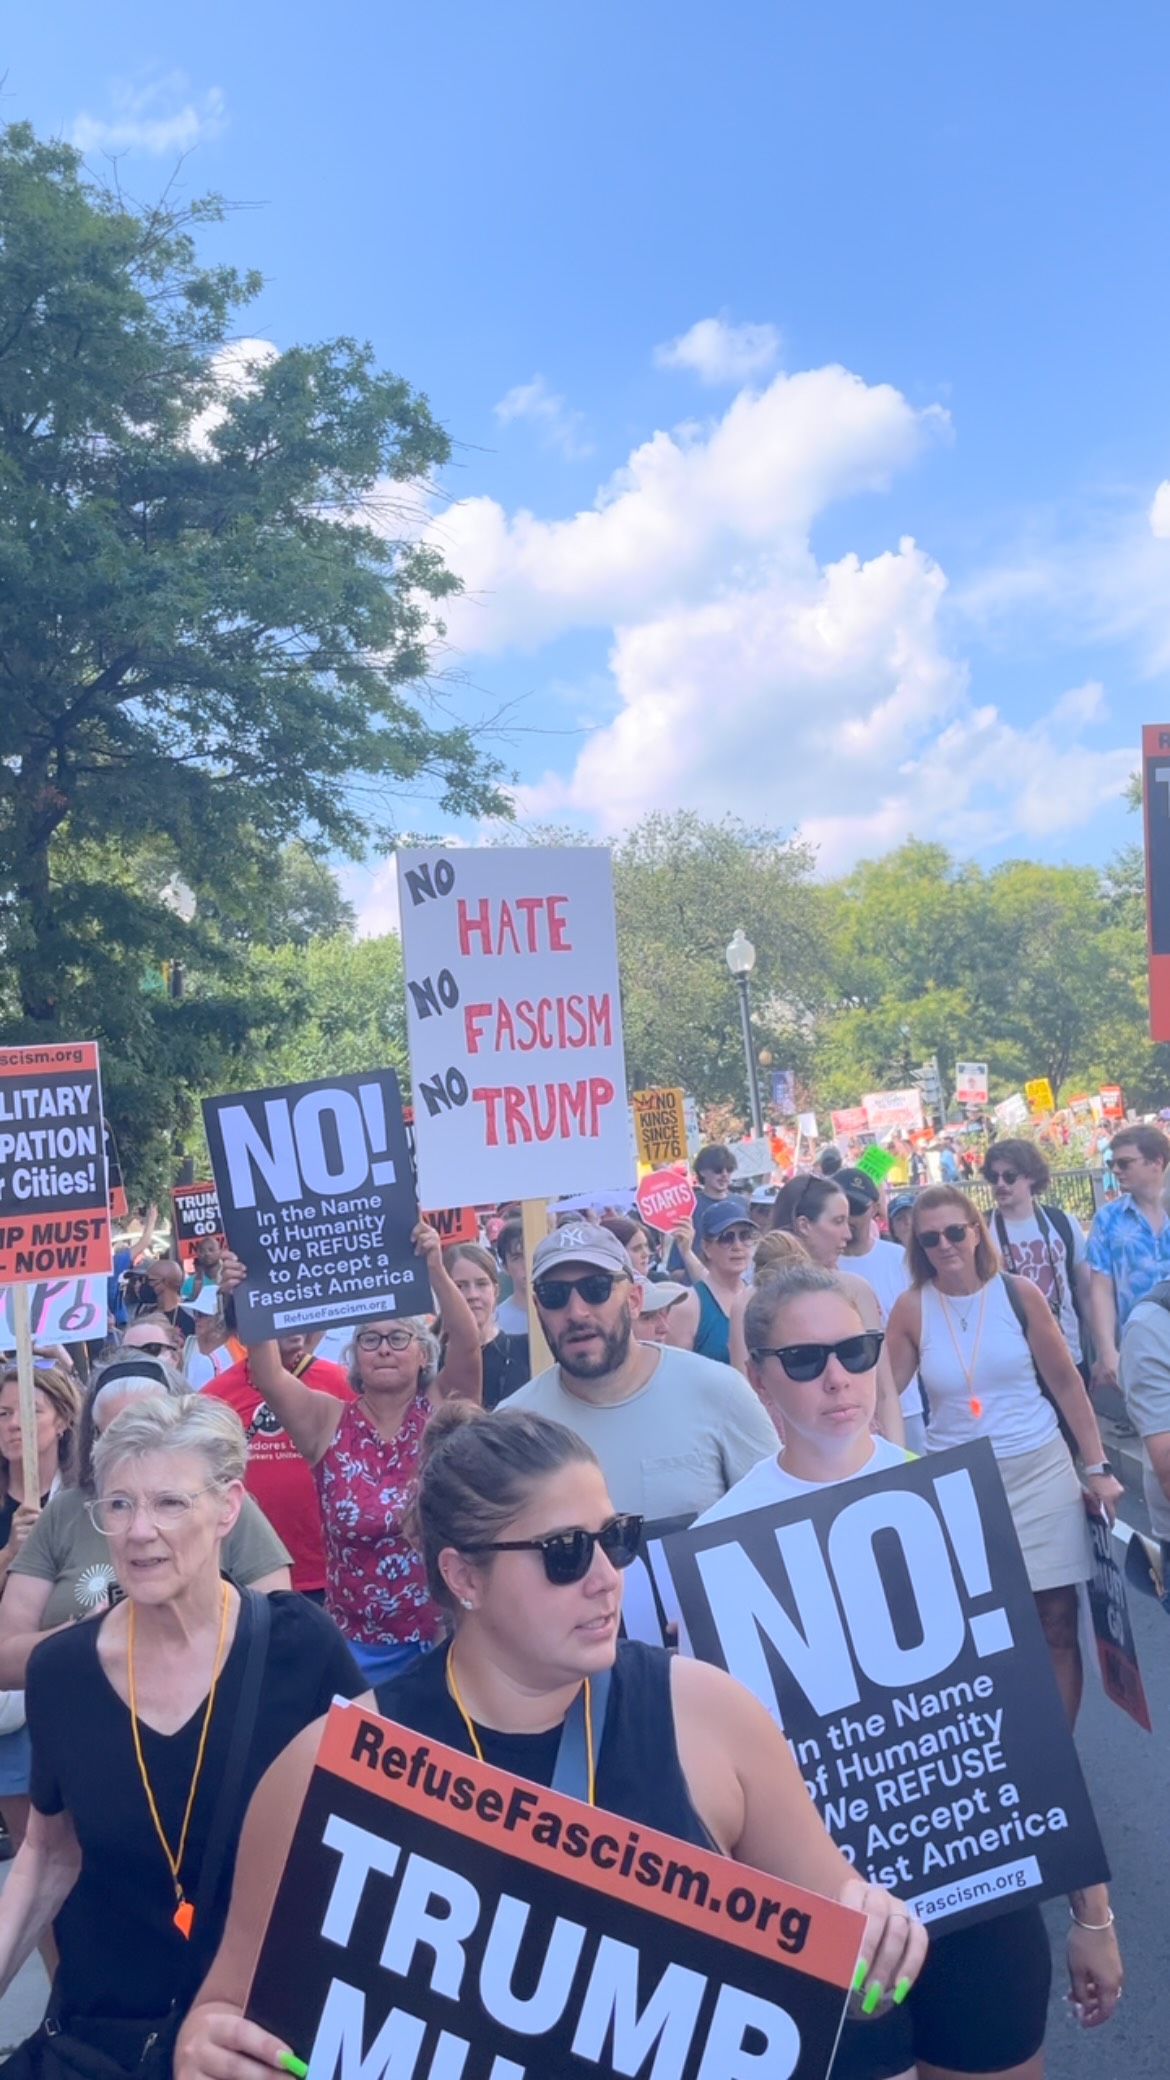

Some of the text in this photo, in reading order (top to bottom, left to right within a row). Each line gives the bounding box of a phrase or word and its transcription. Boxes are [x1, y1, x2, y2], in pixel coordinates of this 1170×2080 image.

[404, 858, 456, 907] NO
[457, 896, 572, 956] HATE
[407, 968, 460, 1020] NO
[463, 993, 613, 1054] FASCISM
[418, 1067, 614, 1147] NO TRUMP
[640, 1109, 679, 1128] KINGS
[656, 1091, 676, 1110] NO
[217, 1083, 397, 1210] NO!
[642, 1125, 680, 1143] SINCE
[643, 1140, 682, 1161] 1776
[12, 1162, 97, 1200] Cities!
[640, 1183, 692, 1217] STARTS
[194, 1221, 217, 1236] GO
[256, 1195, 382, 1227] In the Name
[259, 1214, 386, 1246] of Humanity
[32, 1217, 106, 1247] MUST
[267, 1231, 384, 1264] We REFUSE
[15, 1246, 88, 1274] NOW!
[269, 1254, 389, 1284] to Accept a
[248, 1269, 414, 1308] Fascist America
[283, 1300, 388, 1324] RefuseFascism.org
[247, 1441, 286, 1451] adores
[695, 1468, 1016, 1733] NO!
[827, 1713, 886, 1752] the
[891, 1674, 994, 1728] Name
[836, 1708, 1004, 1788] Humanity
[875, 1740, 1007, 1812] REFUSE
[349, 1719, 812, 1955] RefuseFascism.org
[838, 1782, 1020, 1866] o Accept a
[866, 1805, 1069, 1890] ist America
[319, 1813, 801, 2080] TRUMP
